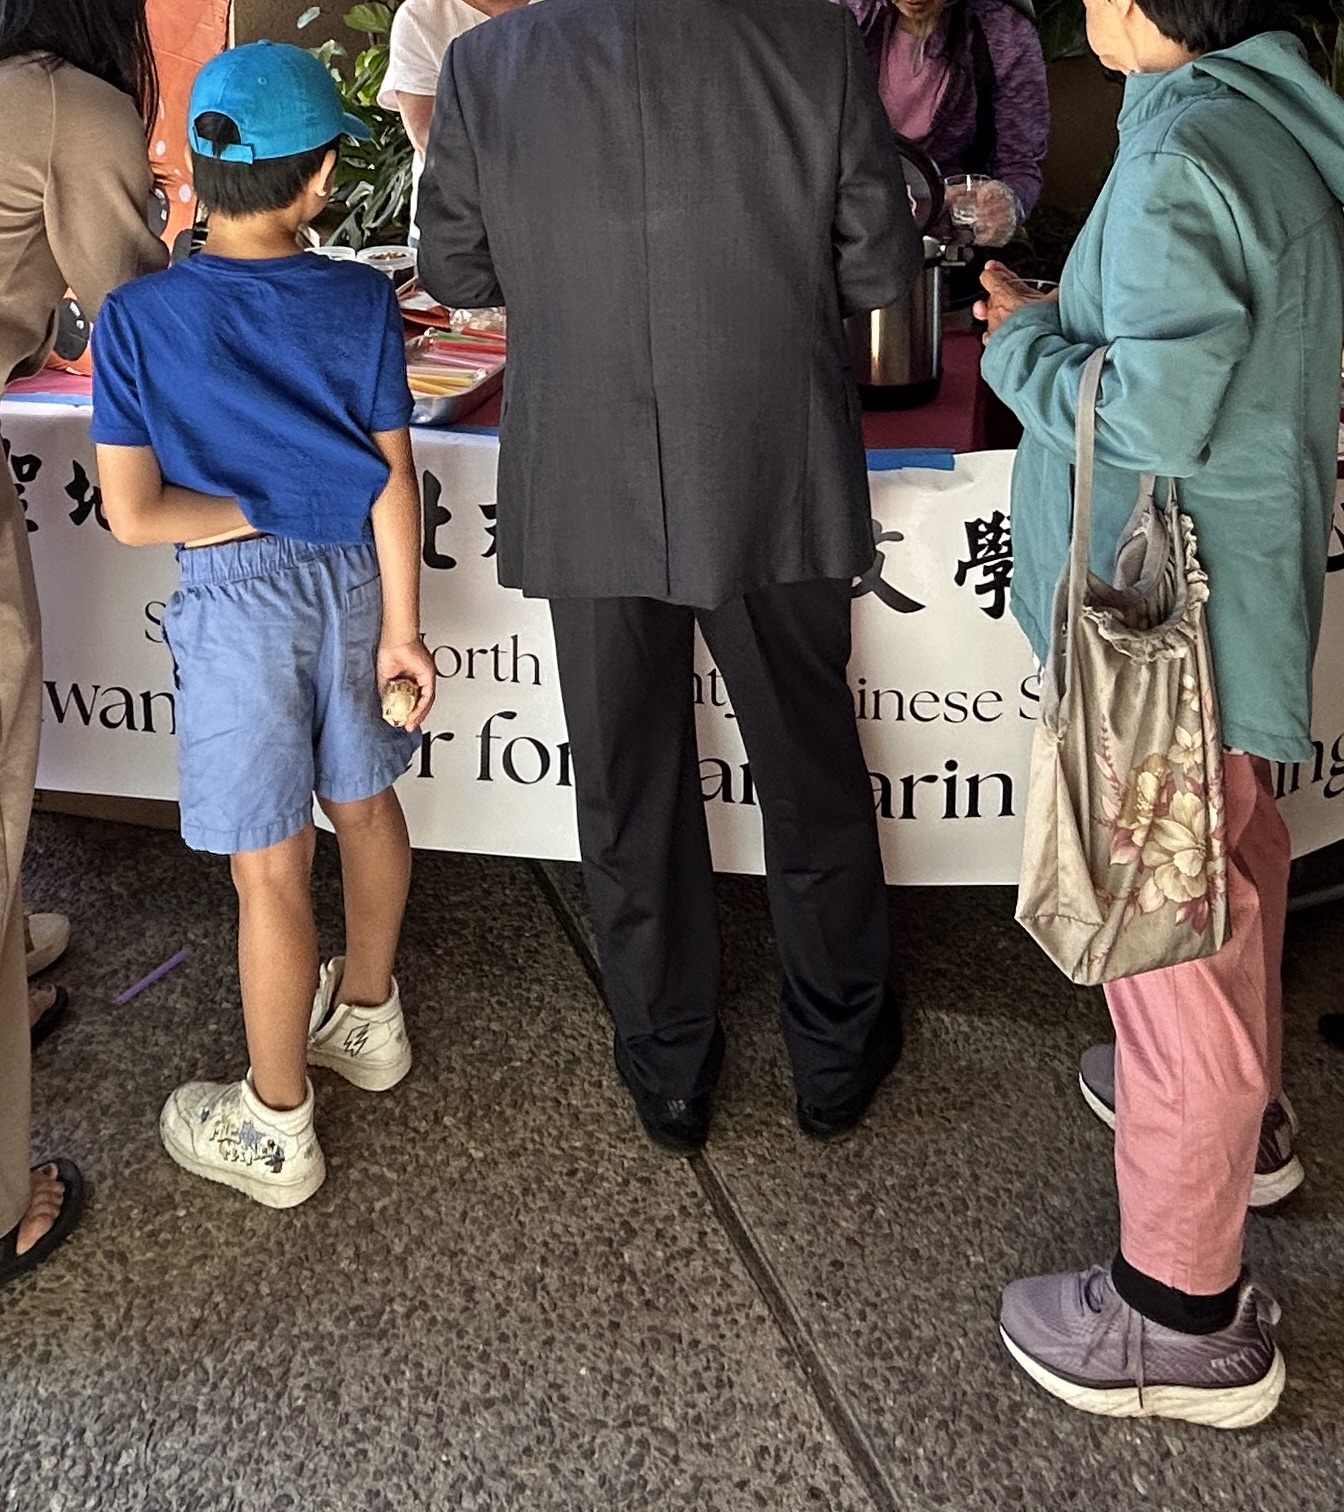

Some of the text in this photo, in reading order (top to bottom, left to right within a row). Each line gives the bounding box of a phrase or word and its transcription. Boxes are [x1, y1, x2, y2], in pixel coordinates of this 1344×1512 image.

[41, 680, 176, 735] wan
[419, 633, 543, 686] orth
[856, 677, 1004, 724] inese
